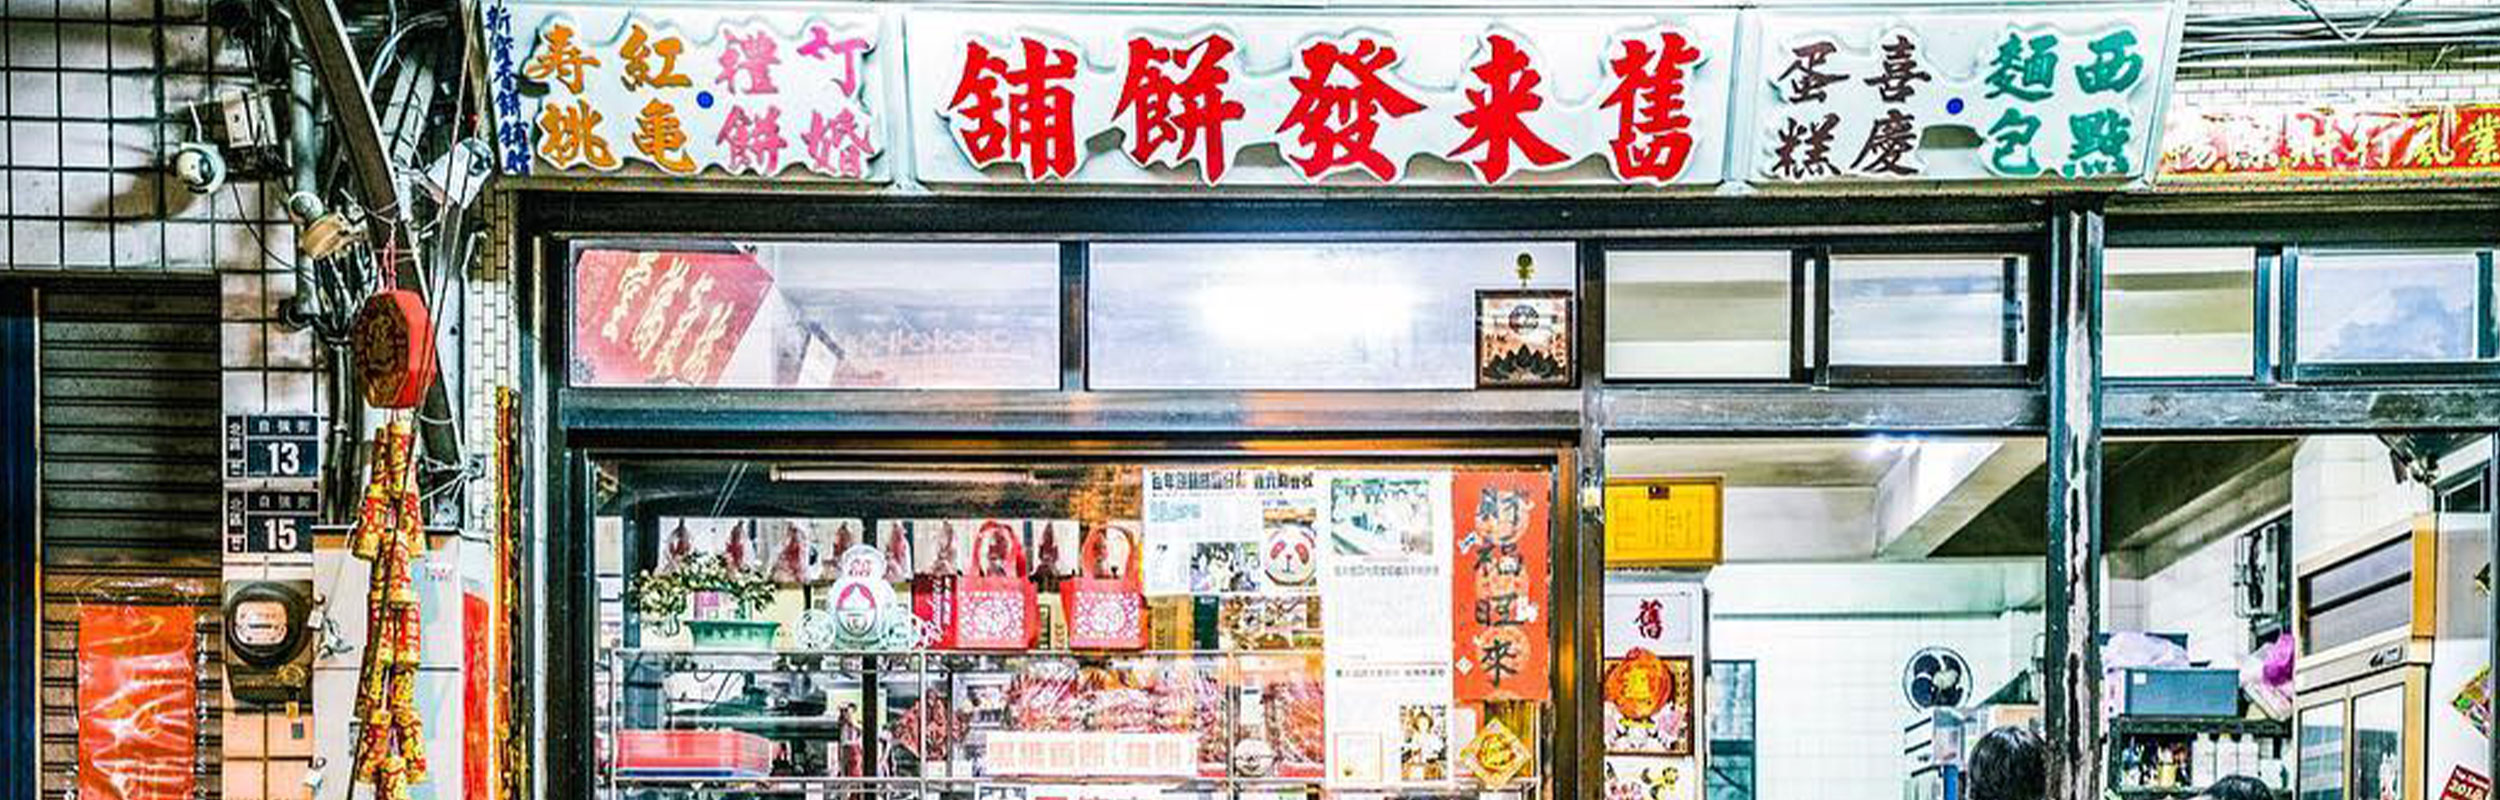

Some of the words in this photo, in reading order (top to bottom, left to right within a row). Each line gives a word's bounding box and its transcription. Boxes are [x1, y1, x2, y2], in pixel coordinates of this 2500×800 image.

[1772, 40, 1850, 179] 蛋糕
[1849, 34, 1931, 175] 喜慶
[1985, 32, 2060, 176] 麵包
[2062, 29, 2144, 177] 西點
[266, 441, 300, 476] 13
[264, 518, 298, 551] 15
